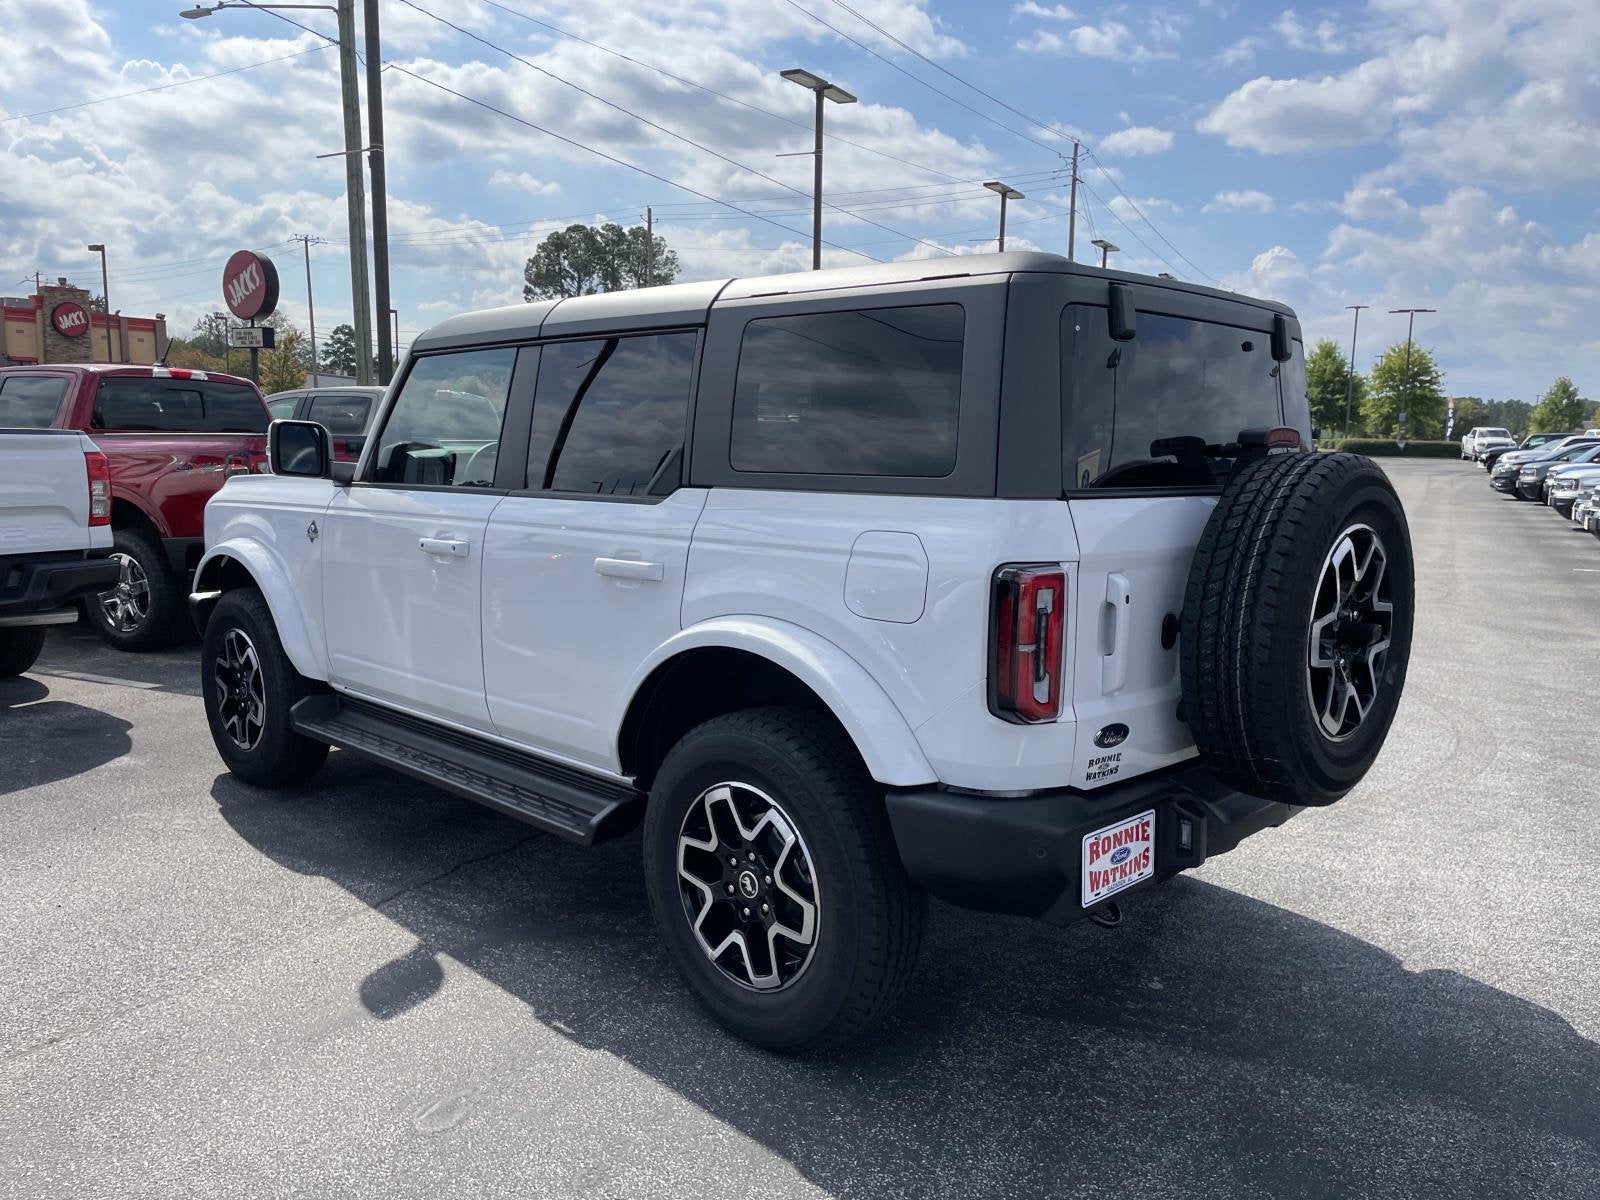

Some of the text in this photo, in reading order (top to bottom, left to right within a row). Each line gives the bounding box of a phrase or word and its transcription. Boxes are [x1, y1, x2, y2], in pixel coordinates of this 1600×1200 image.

[1086, 764, 1120, 781] WATKINS
[1088, 752, 1122, 769] RONNIE
[1089, 820, 1150, 866] RONNIE
[1089, 846, 1150, 893] WATKINS
